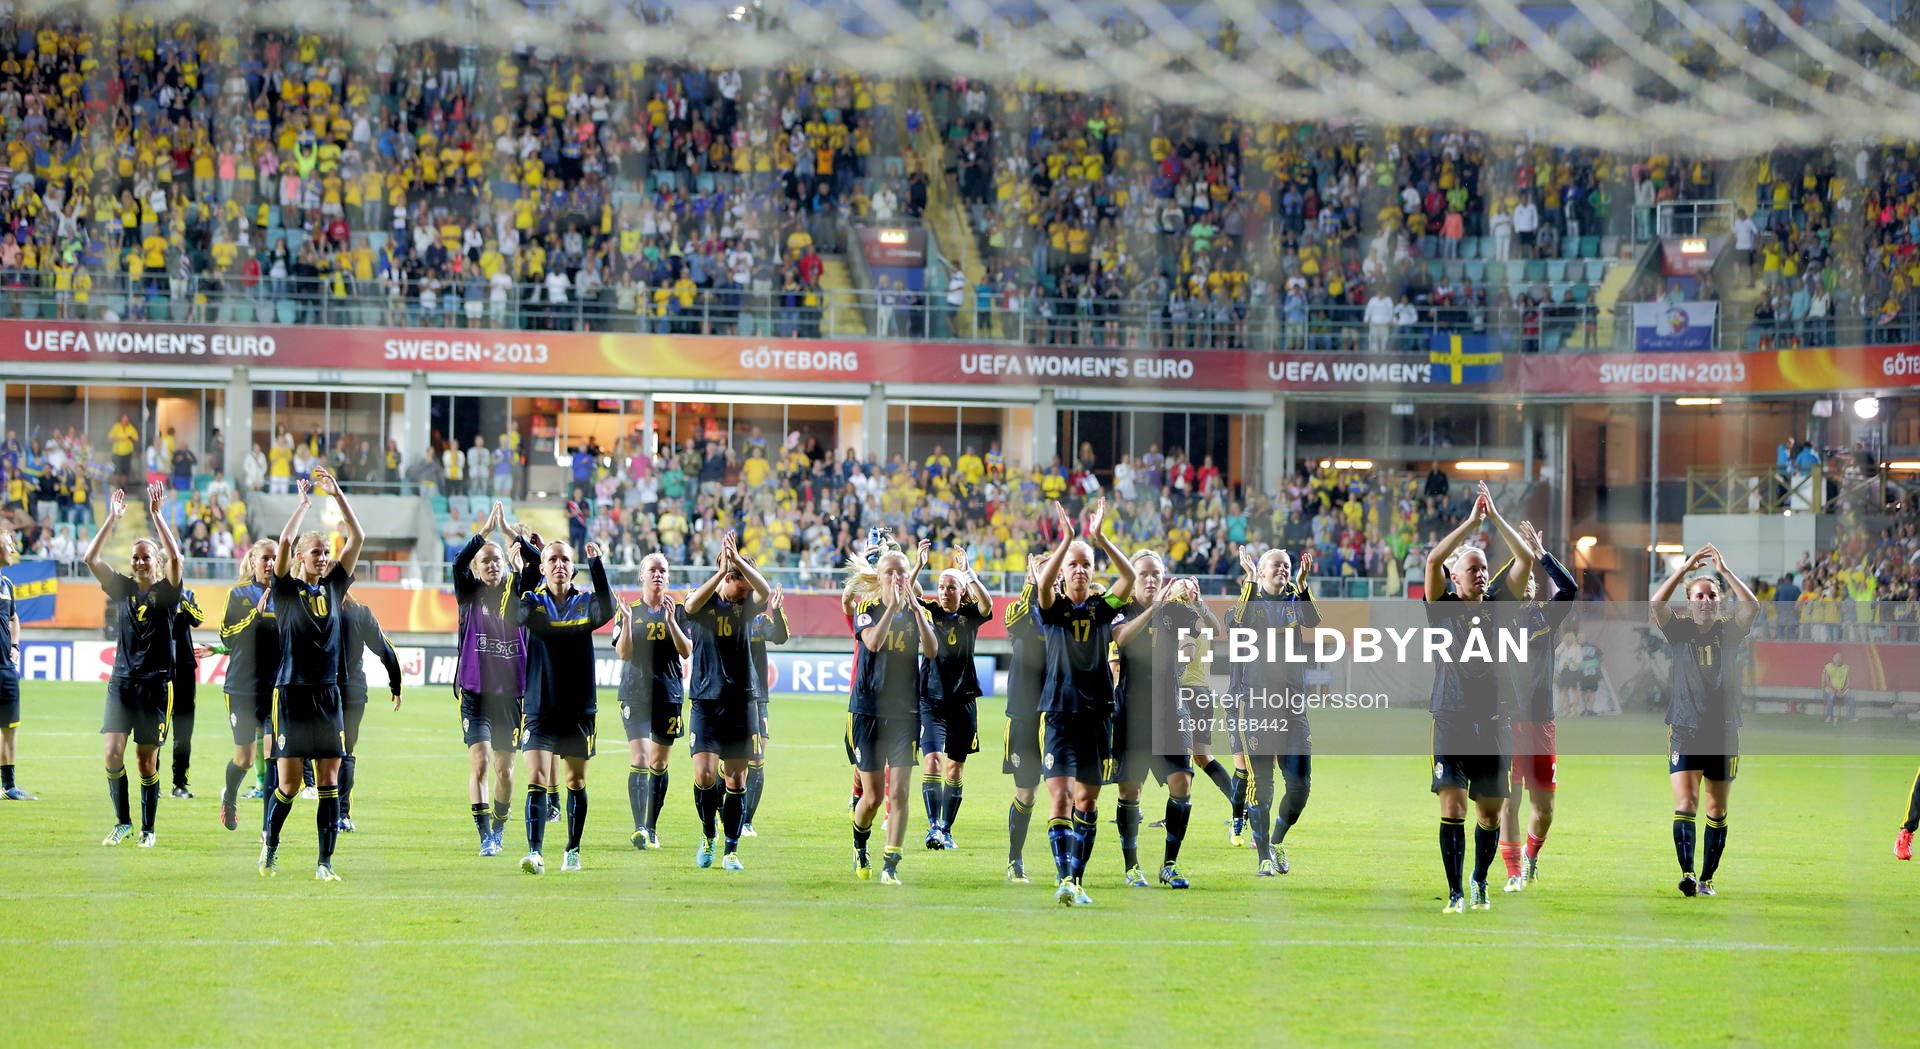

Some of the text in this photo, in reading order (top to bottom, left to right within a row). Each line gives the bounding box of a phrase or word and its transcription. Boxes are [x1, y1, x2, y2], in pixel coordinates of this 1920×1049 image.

[24, 330, 276, 357] UEFA WOMEN'S EURO
[739, 346, 859, 371] GÖTEBORG
[960, 354, 1194, 379] UEFA WOMEN'S EURO
[1268, 361, 1329, 382] UEFA
[137, 605, 148, 621] 2
[309, 596, 327, 617] 10
[647, 622, 666, 641] 23
[717, 616, 733, 637] 16
[948, 626, 957, 646] 6
[1072, 619, 1091, 642] 17
[887, 631, 905, 652] 14
[1698, 645, 1713, 666] 11
[792, 660, 851, 692] RES
